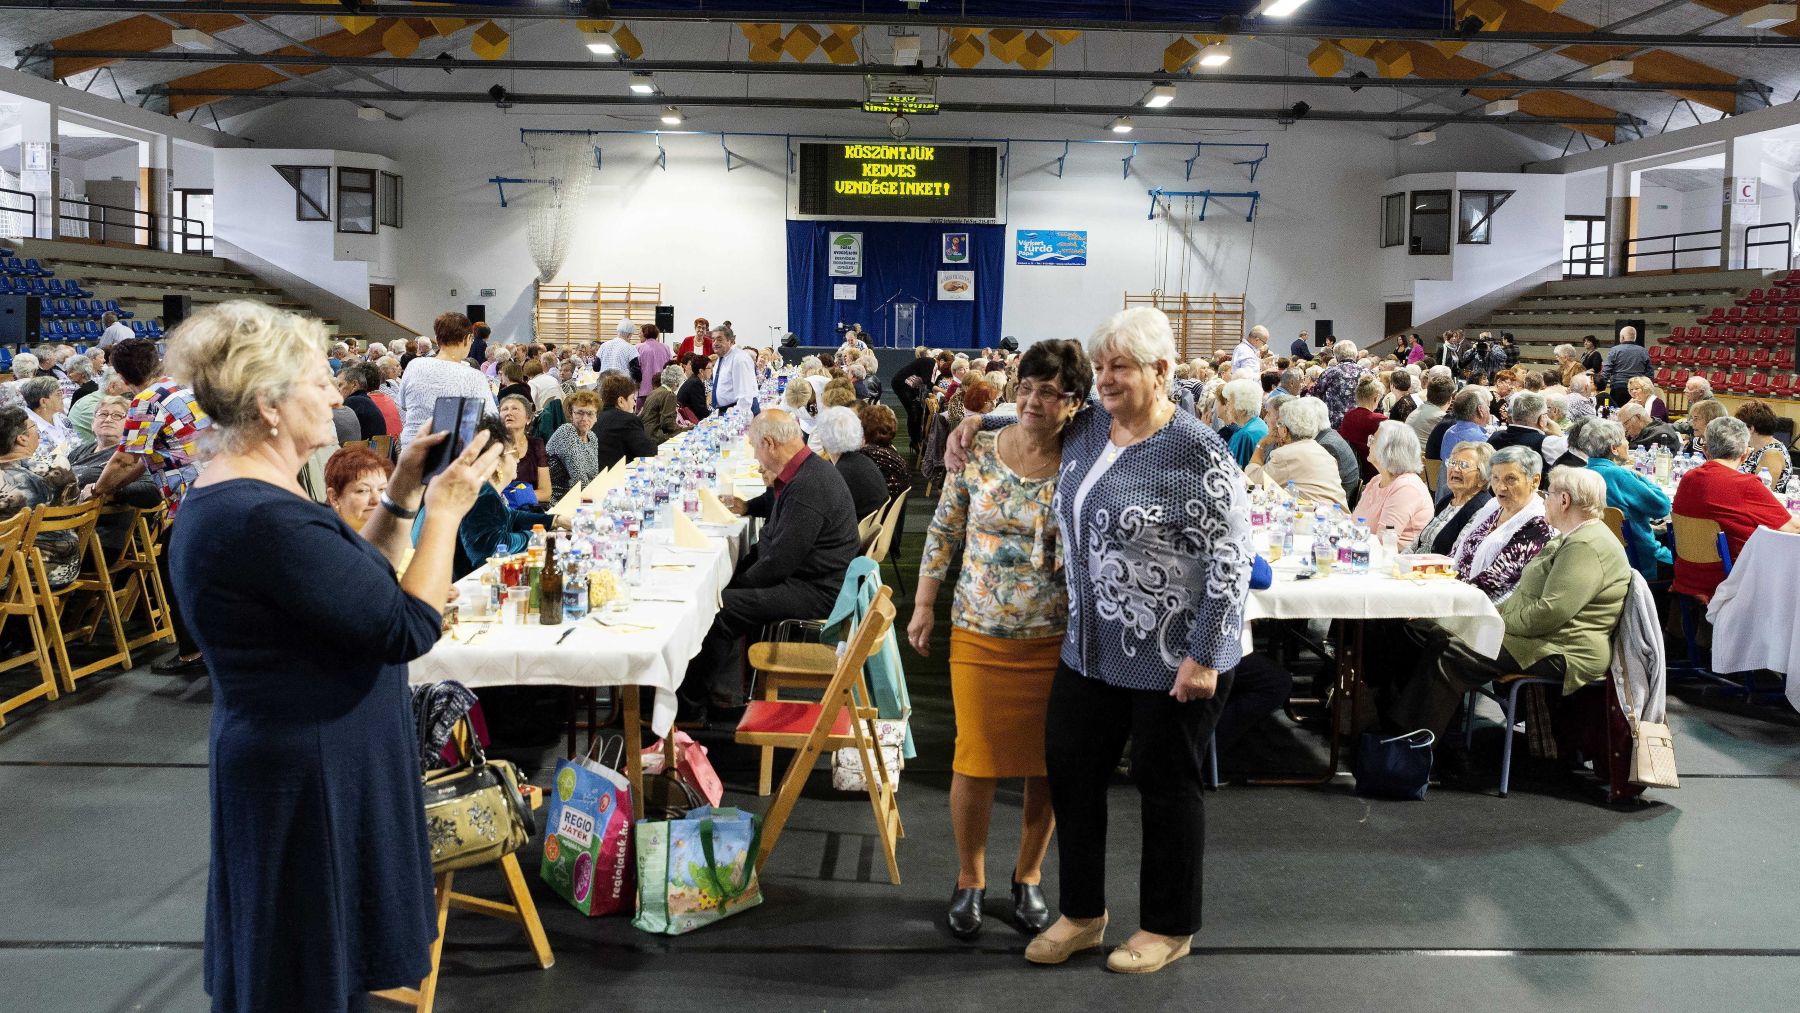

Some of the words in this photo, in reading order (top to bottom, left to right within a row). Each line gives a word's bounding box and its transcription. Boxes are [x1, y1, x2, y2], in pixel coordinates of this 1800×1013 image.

[844, 145, 935, 160] KÖSZÖNTJÜK
[862, 163, 916, 177] KEDVES
[834, 179, 950, 195] VENDÉGEINKET!
[1742, 185, 1751, 197] C
[564, 811, 592, 833] REGIO
[611, 820, 630, 899] regiojatek.hu
